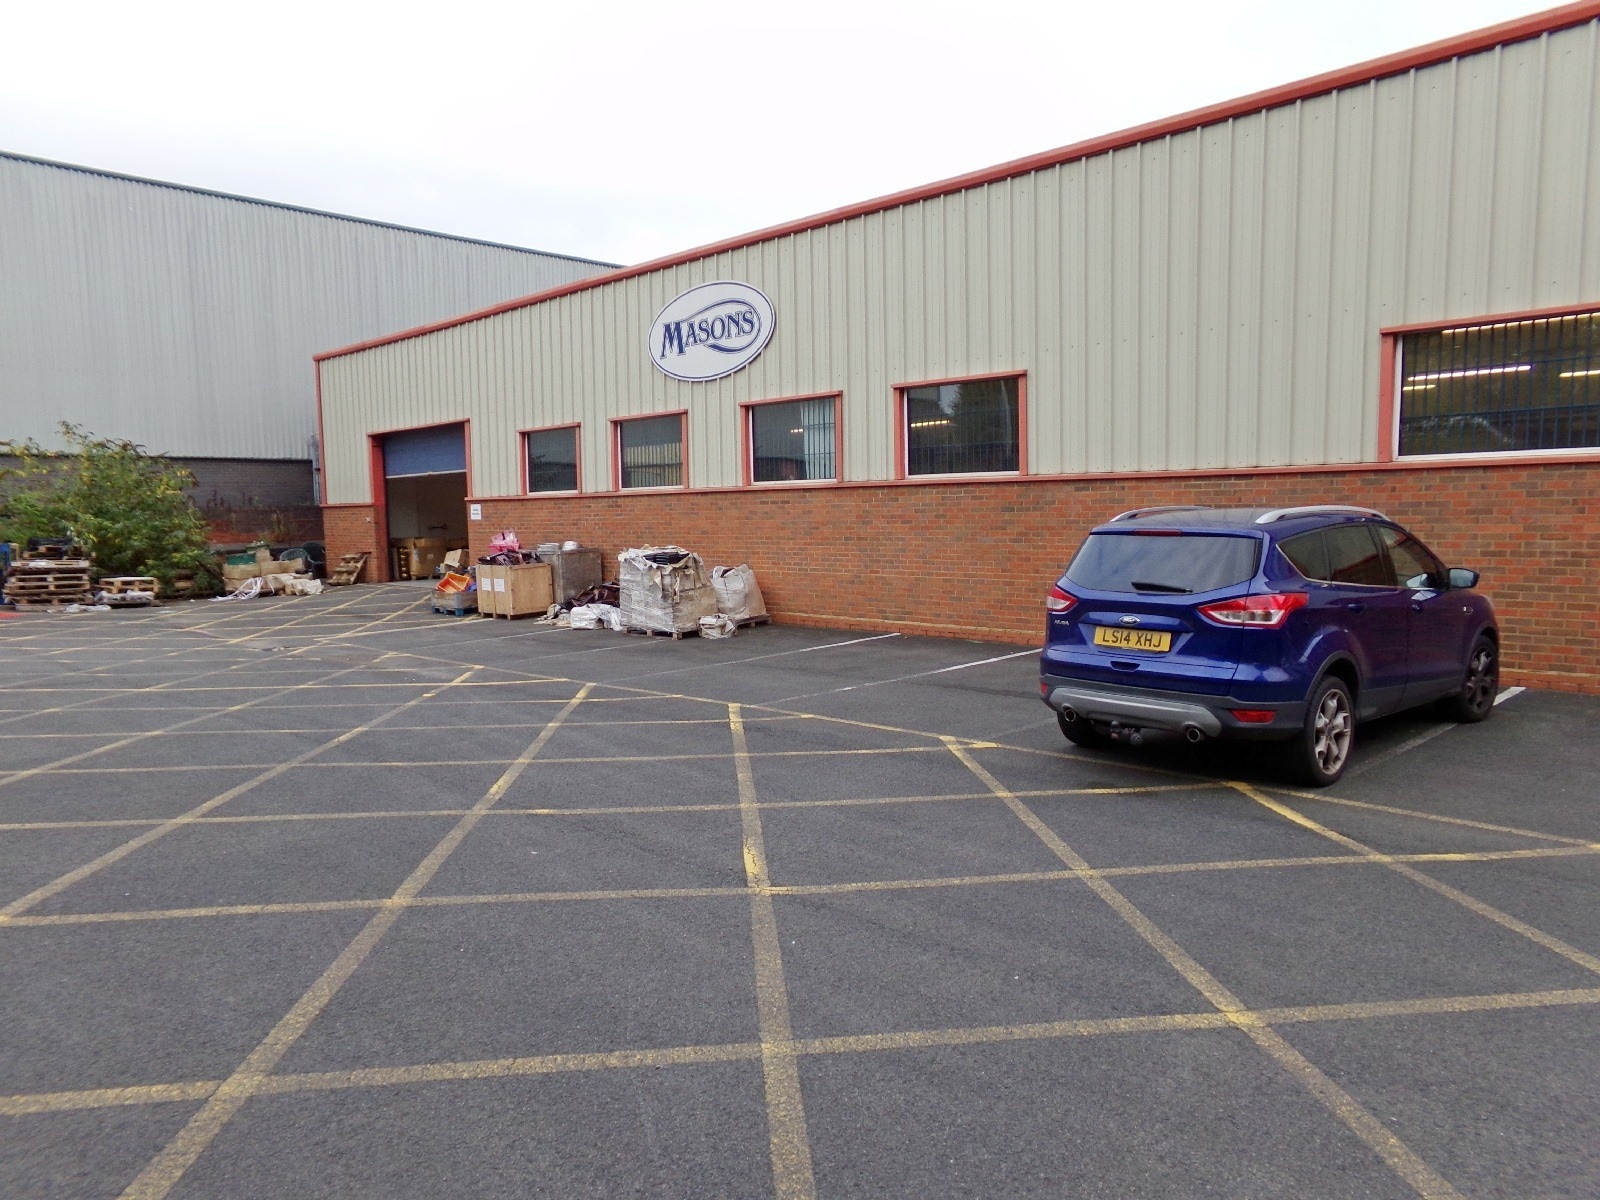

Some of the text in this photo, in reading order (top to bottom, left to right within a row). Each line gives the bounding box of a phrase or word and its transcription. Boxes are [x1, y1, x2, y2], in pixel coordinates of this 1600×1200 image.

[660, 310, 754, 359] MASONS
[1102, 629, 1163, 648] LS14 XHJ
